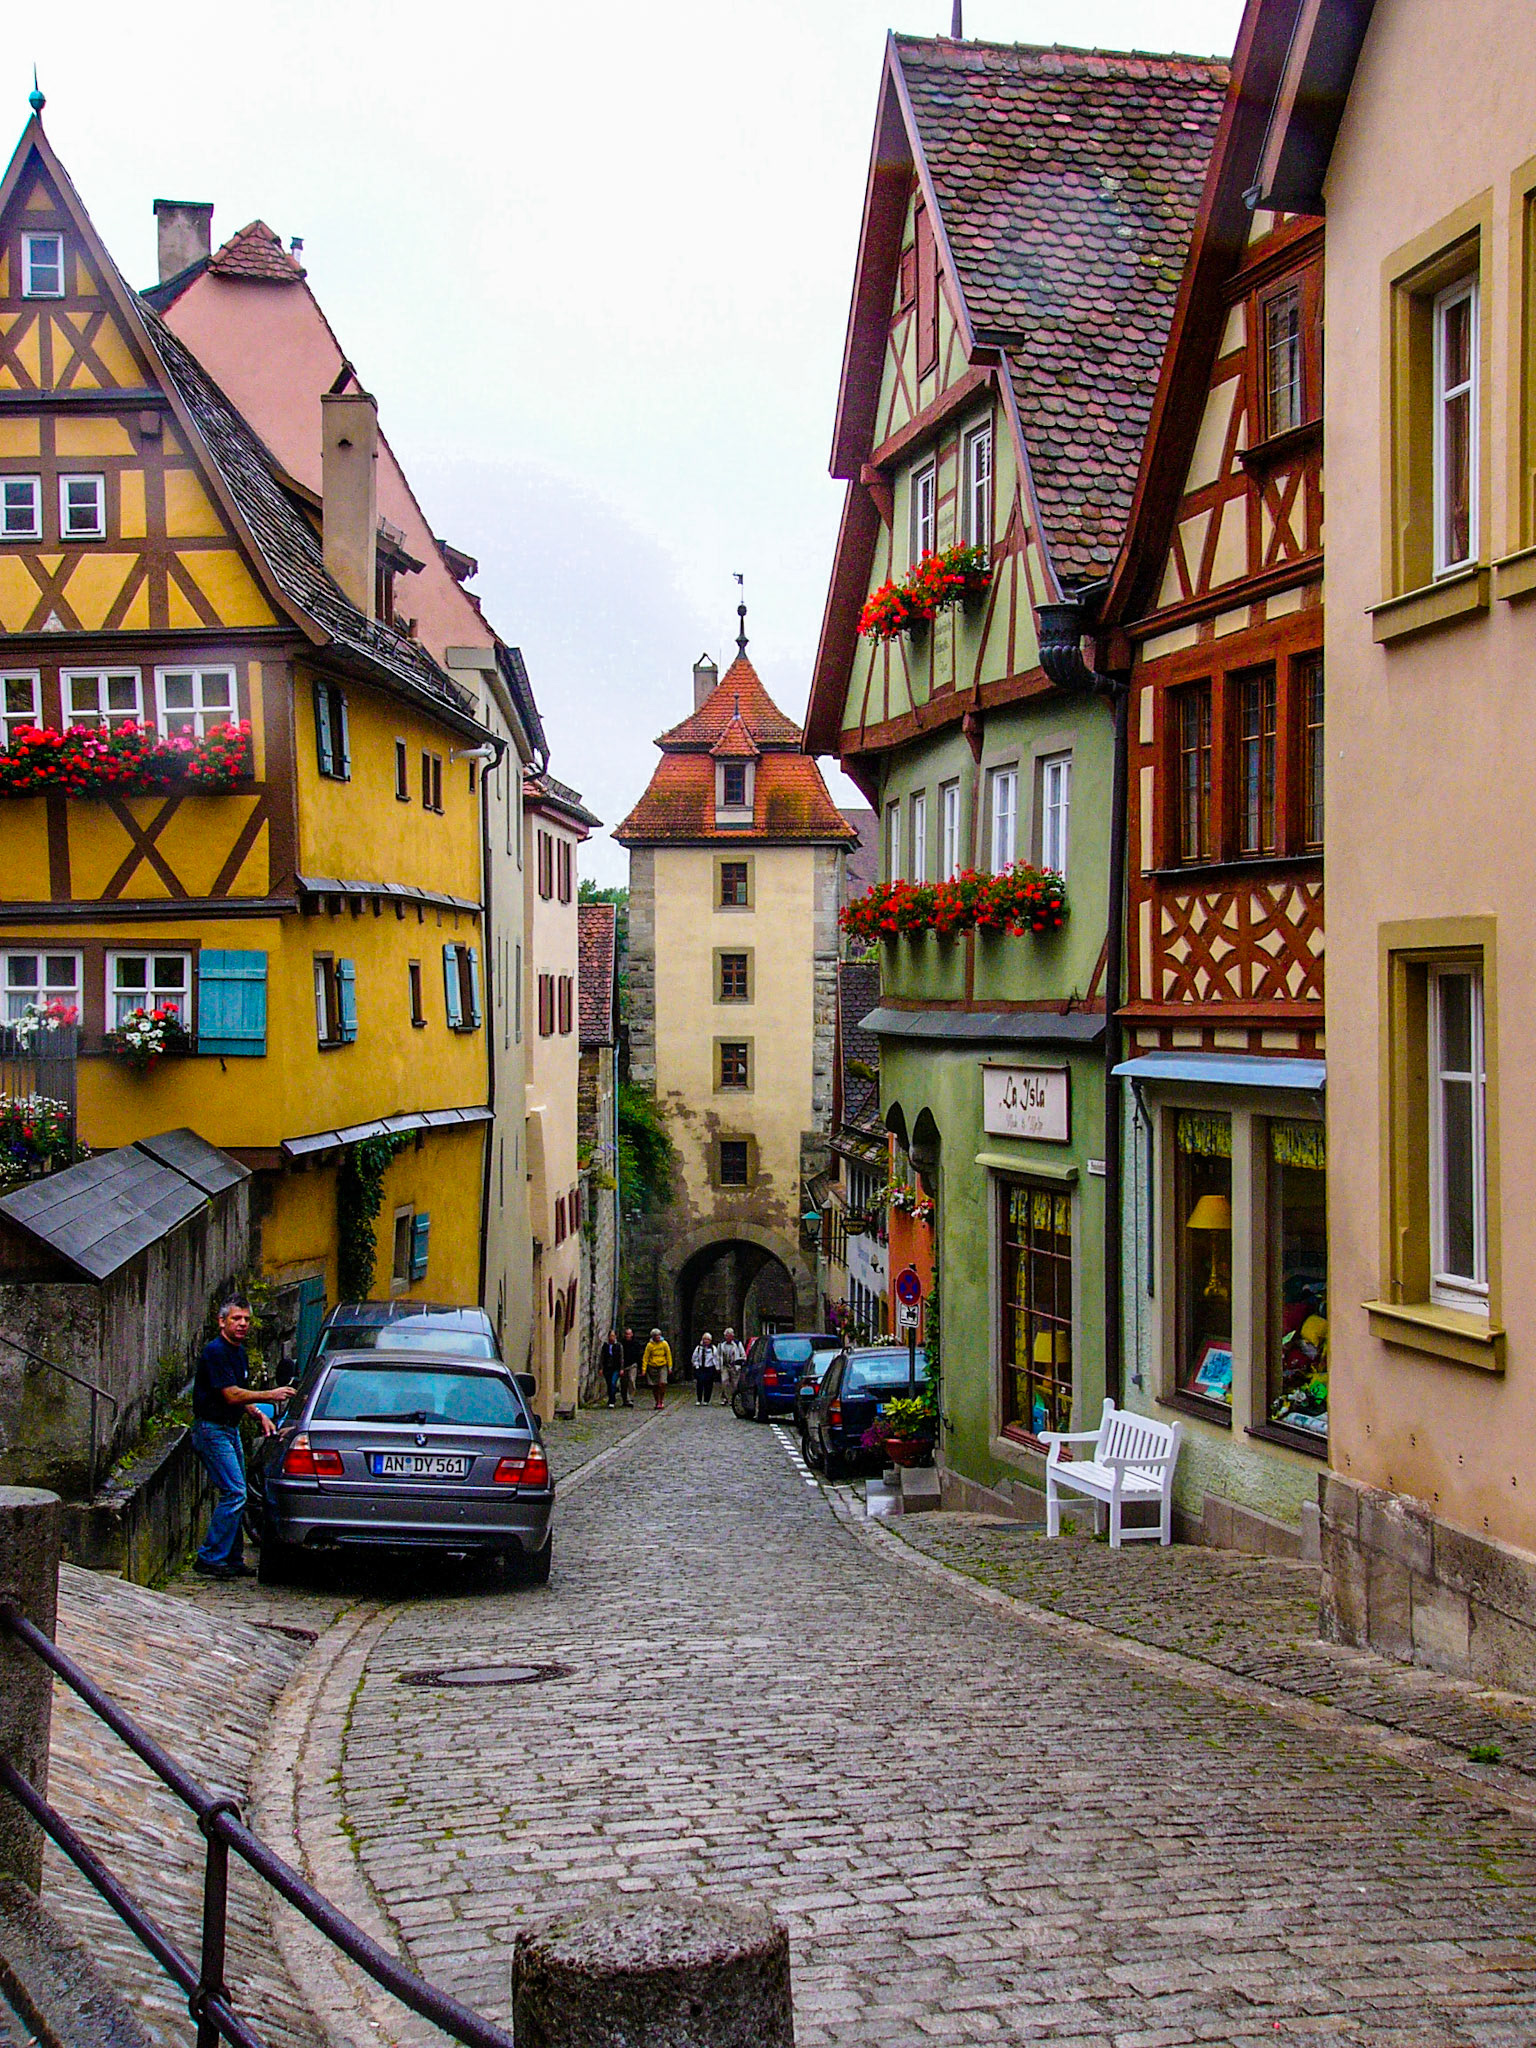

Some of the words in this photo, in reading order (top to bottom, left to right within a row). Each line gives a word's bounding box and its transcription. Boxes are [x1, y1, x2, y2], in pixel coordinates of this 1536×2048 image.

[384, 1456, 404, 1472] AN
[414, 1457, 435, 1472] DY
[436, 1459, 464, 1473] 561
